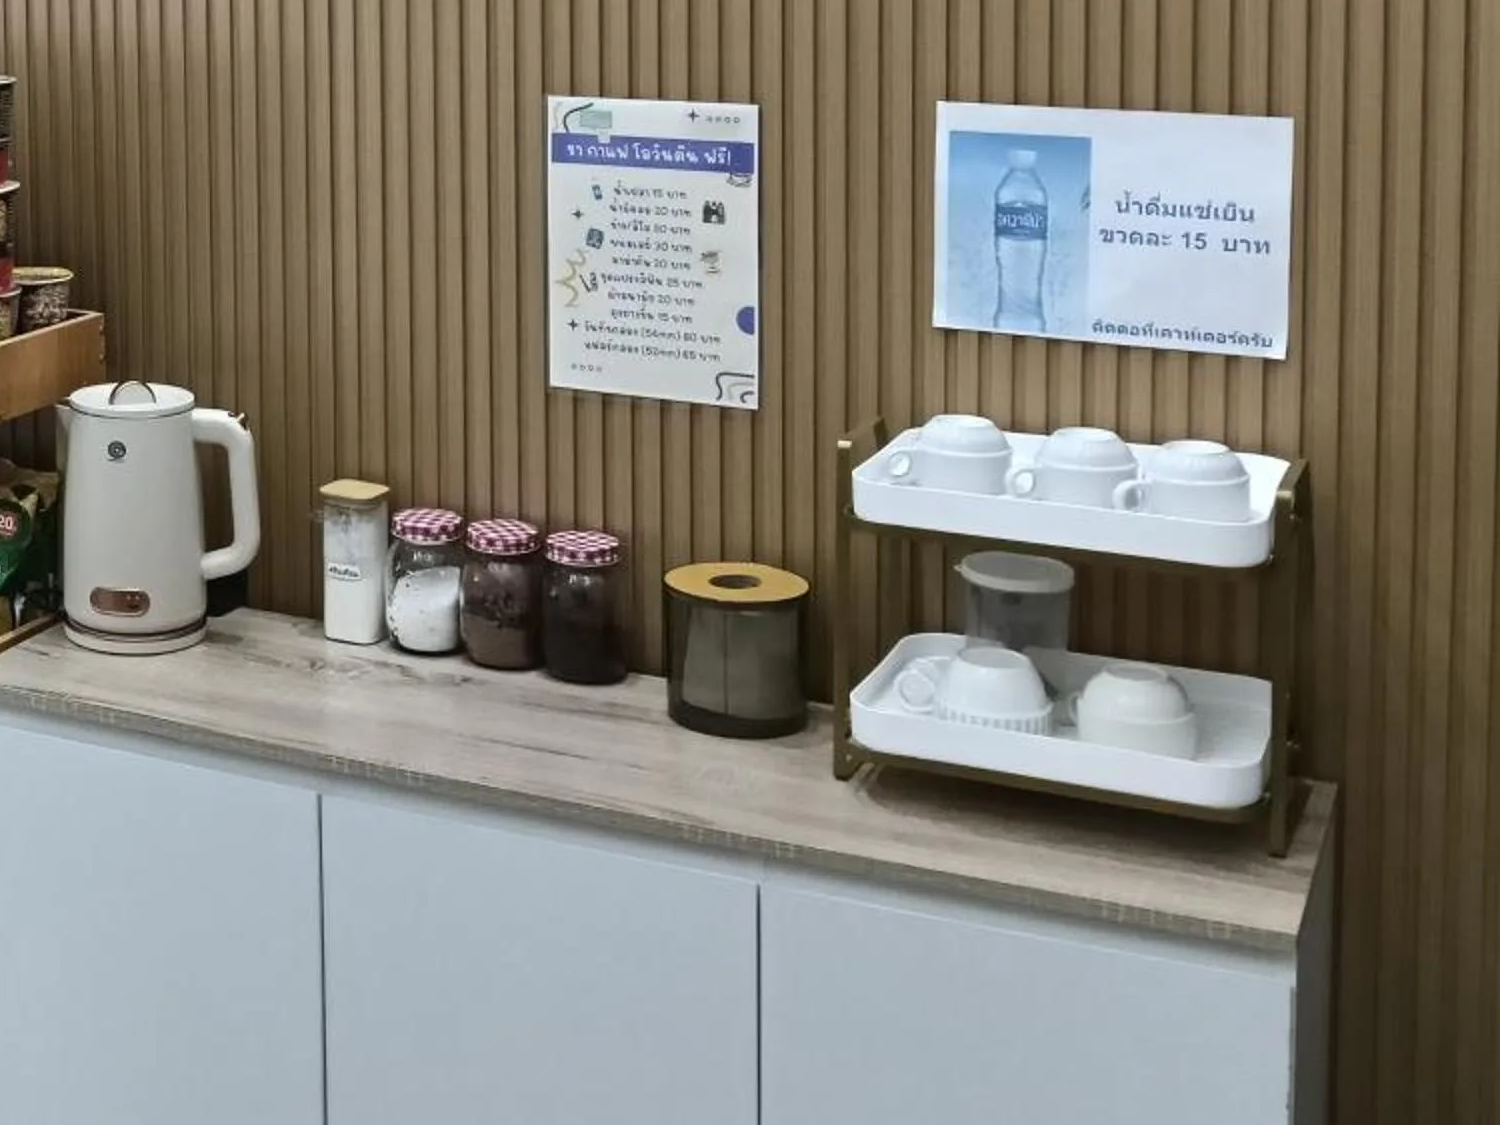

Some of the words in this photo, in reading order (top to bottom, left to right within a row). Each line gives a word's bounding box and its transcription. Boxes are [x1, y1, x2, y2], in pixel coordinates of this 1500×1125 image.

[1098, 227, 1173, 247] ขวดละ
[1181, 231, 1208, 250] 15
[1221, 236, 1271, 255] บาท
